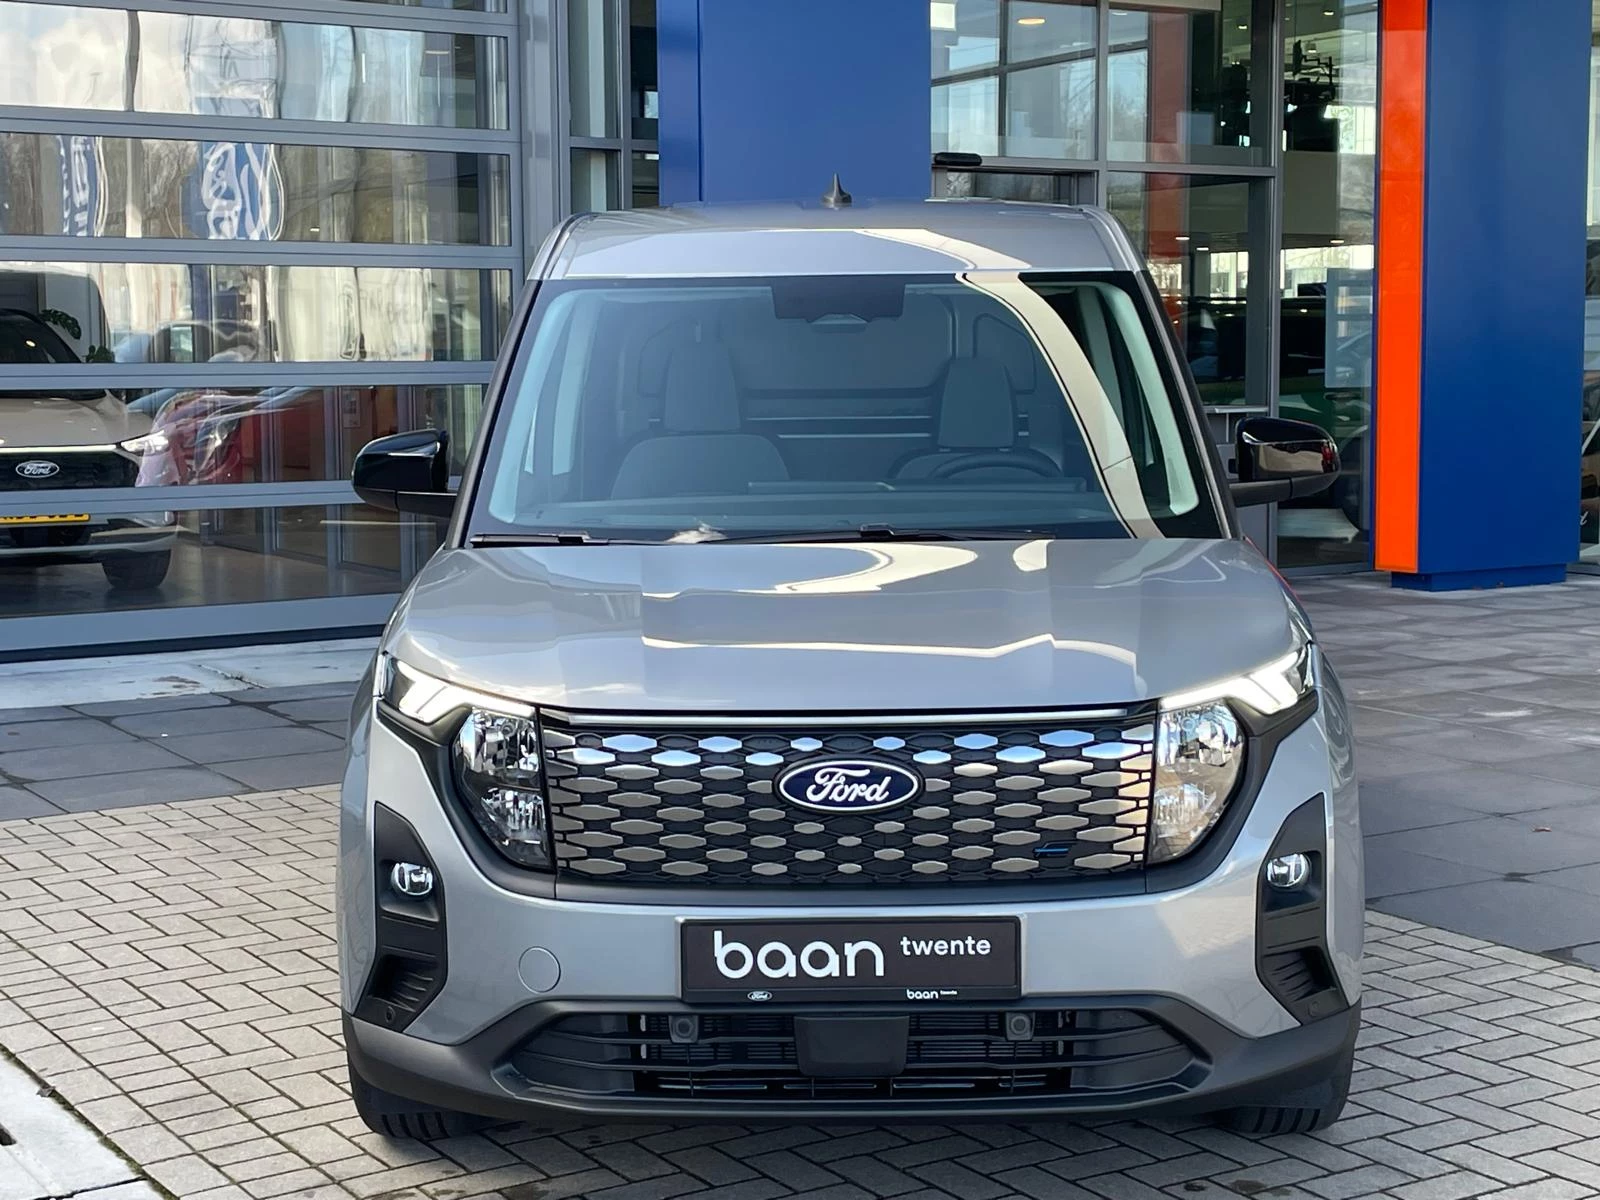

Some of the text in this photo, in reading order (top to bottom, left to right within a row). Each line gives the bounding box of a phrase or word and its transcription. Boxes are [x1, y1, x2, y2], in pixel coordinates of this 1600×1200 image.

[23, 462, 51, 475] Ford
[805, 767, 891, 802] Ford
[713, 930, 991, 979] baan twente
[906, 989, 939, 999] baan
